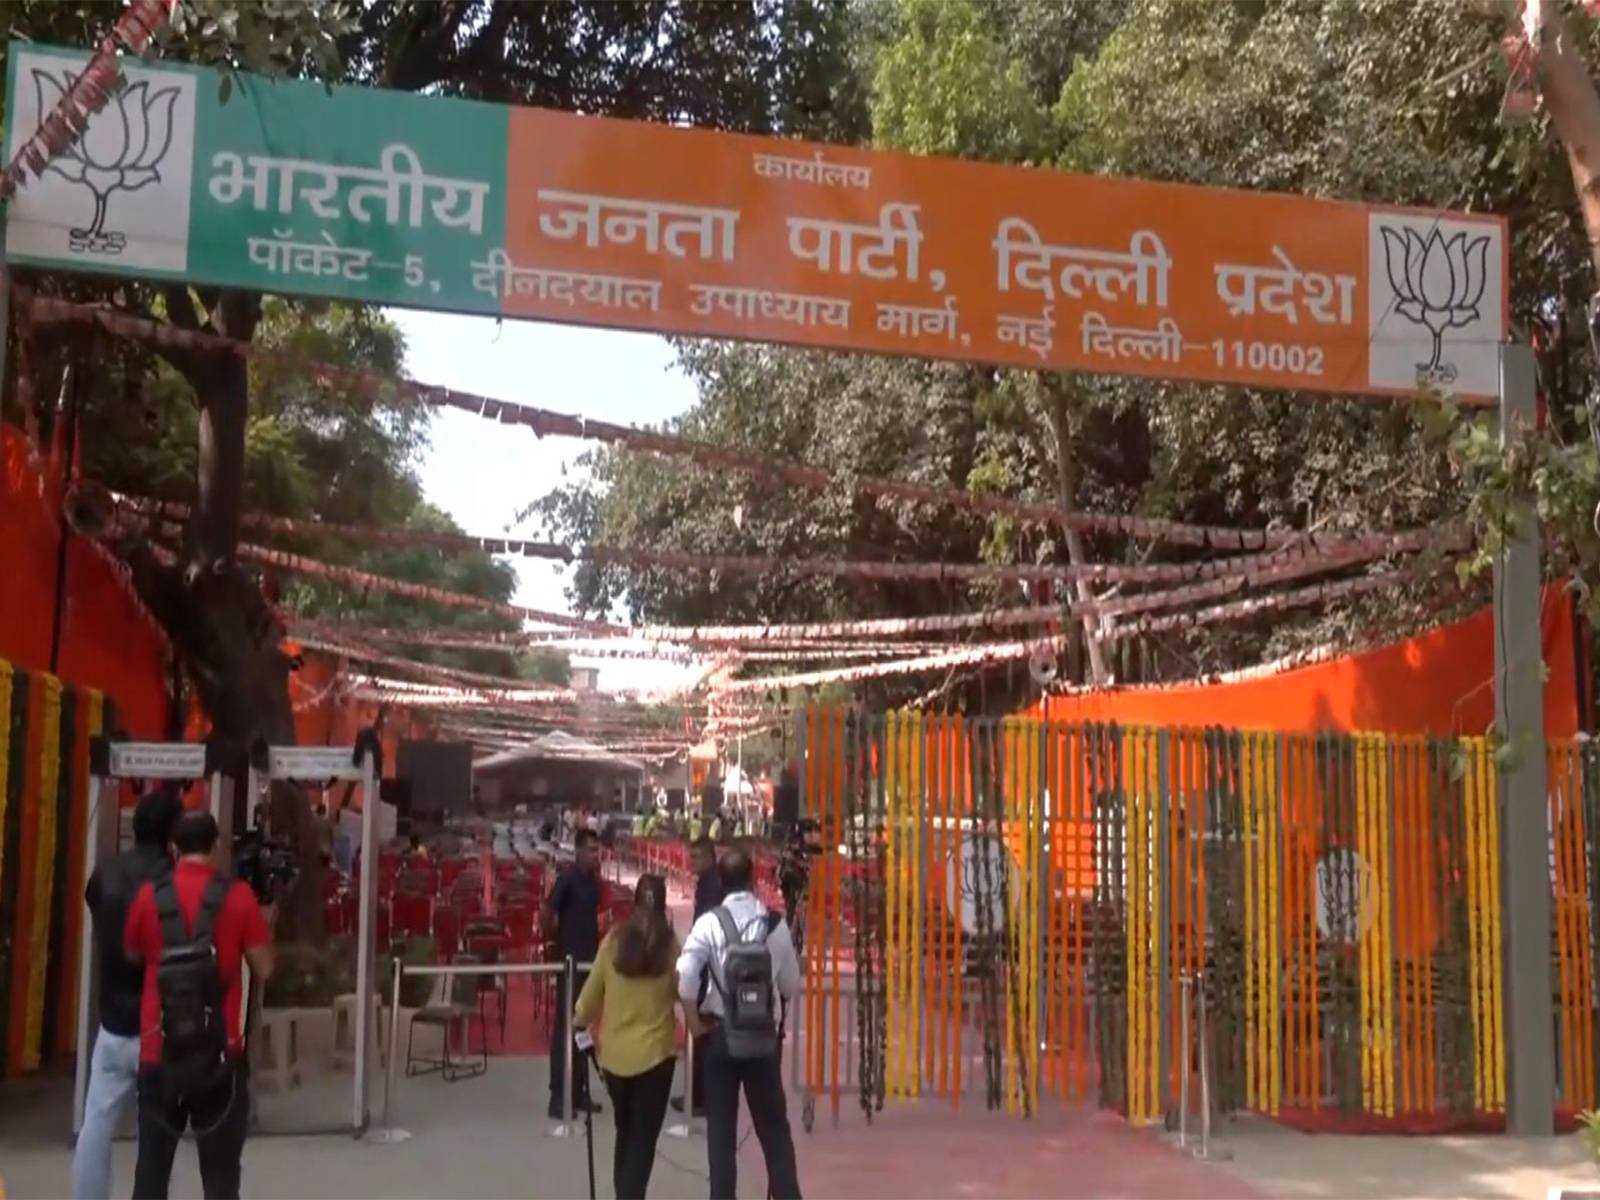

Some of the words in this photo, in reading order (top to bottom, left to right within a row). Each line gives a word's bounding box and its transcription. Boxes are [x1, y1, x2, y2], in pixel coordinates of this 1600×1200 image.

[754, 151, 873, 190] कार्यालय
[208, 143, 490, 236] भारतीय
[537, 189, 740, 261] जनता
[992, 216, 1173, 307] दिल्ली
[1214, 244, 1357, 325] प्रदेश
[471, 248, 662, 311] दीनदयाल
[688, 283, 851, 330] उपाध्याय
[996, 299, 1056, 360] नई
